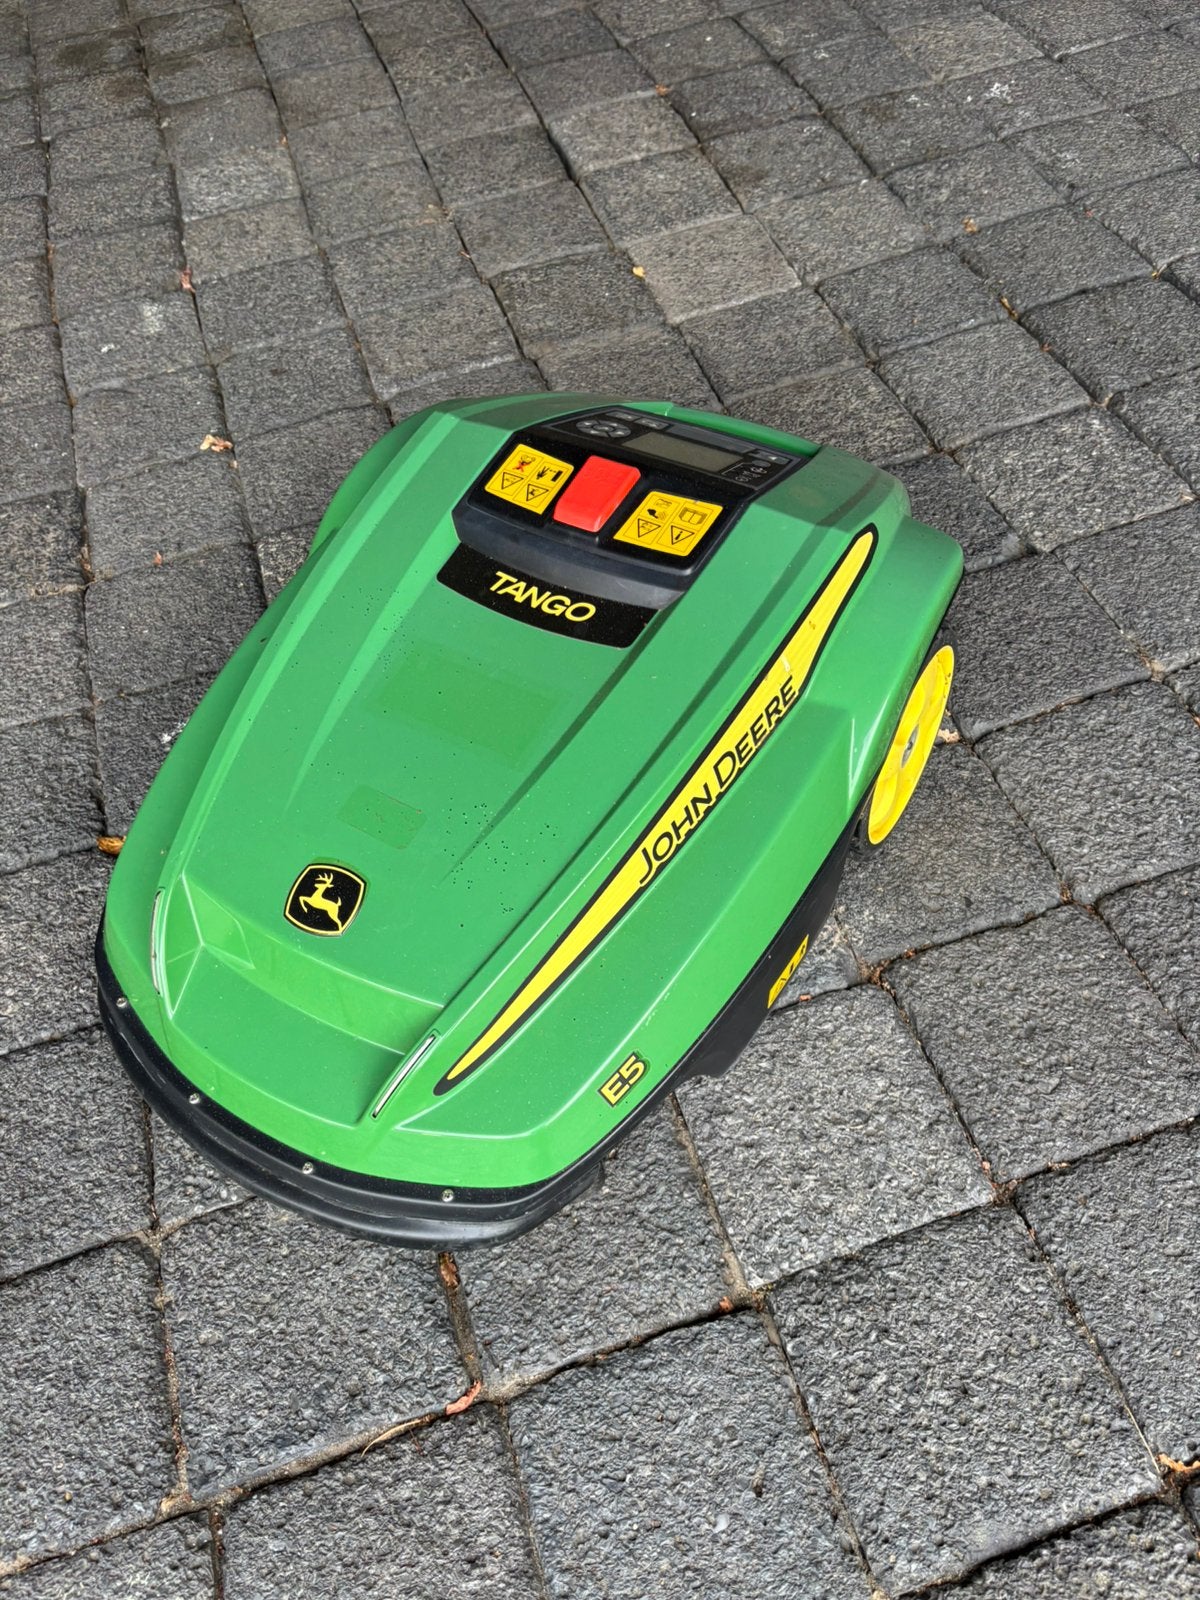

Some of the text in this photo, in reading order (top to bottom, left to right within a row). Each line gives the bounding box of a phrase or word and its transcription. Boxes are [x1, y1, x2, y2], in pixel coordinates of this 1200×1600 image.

[490, 571, 597, 622] TANGO
[640, 675, 797, 884] JOHN DEERE
[600, 1055, 645, 1105] E5
